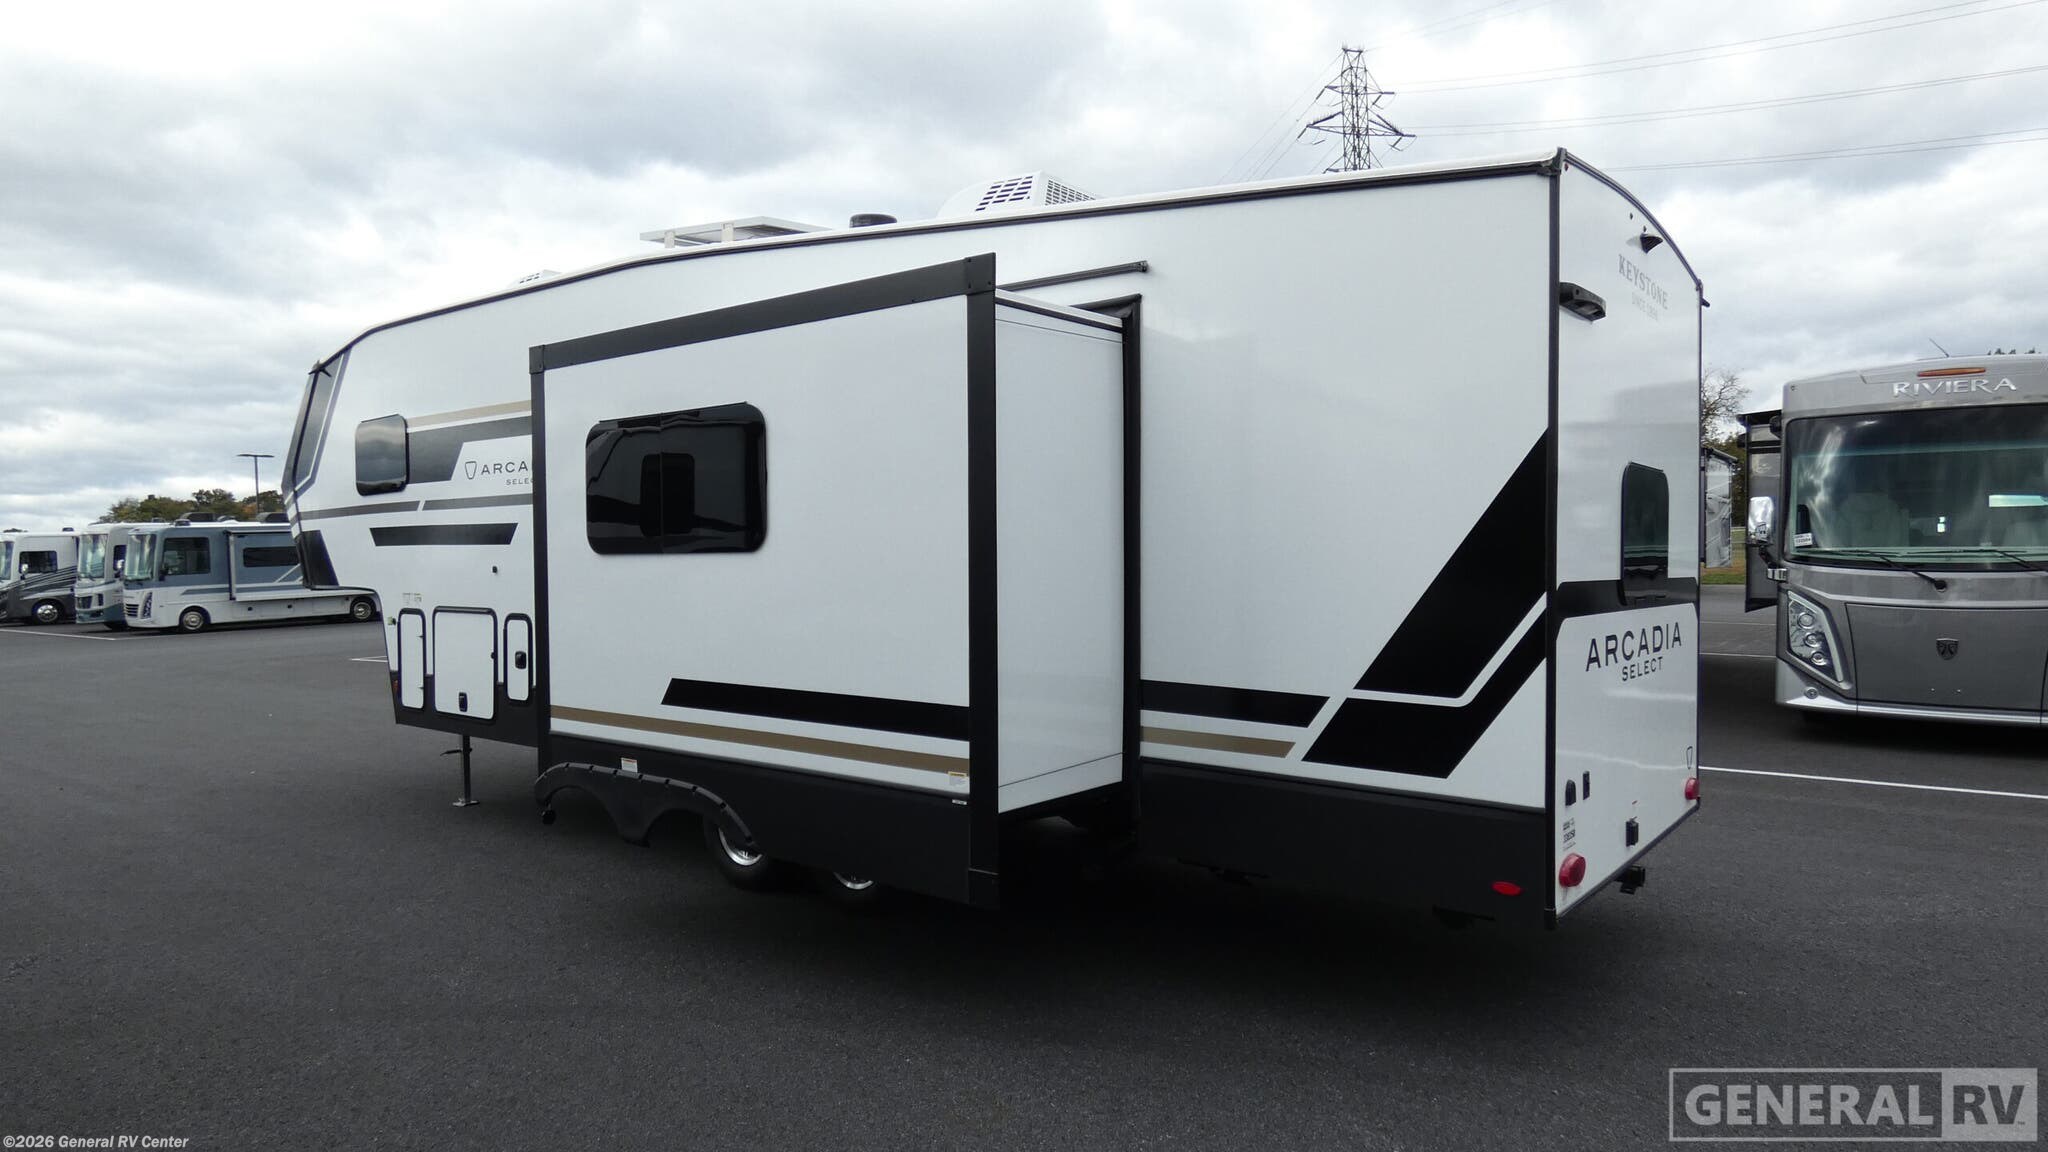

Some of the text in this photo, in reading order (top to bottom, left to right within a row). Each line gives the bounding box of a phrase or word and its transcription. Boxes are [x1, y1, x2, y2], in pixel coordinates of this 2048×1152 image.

[1617, 254, 1669, 311] KEYSTONE
[1893, 377, 2018, 398] RIVIERA
[480, 460, 529, 475] ARCA
[505, 477, 533, 486] SELE
[1585, 621, 1682, 672] ARCADIA
[1621, 656, 1663, 682] SELECT
